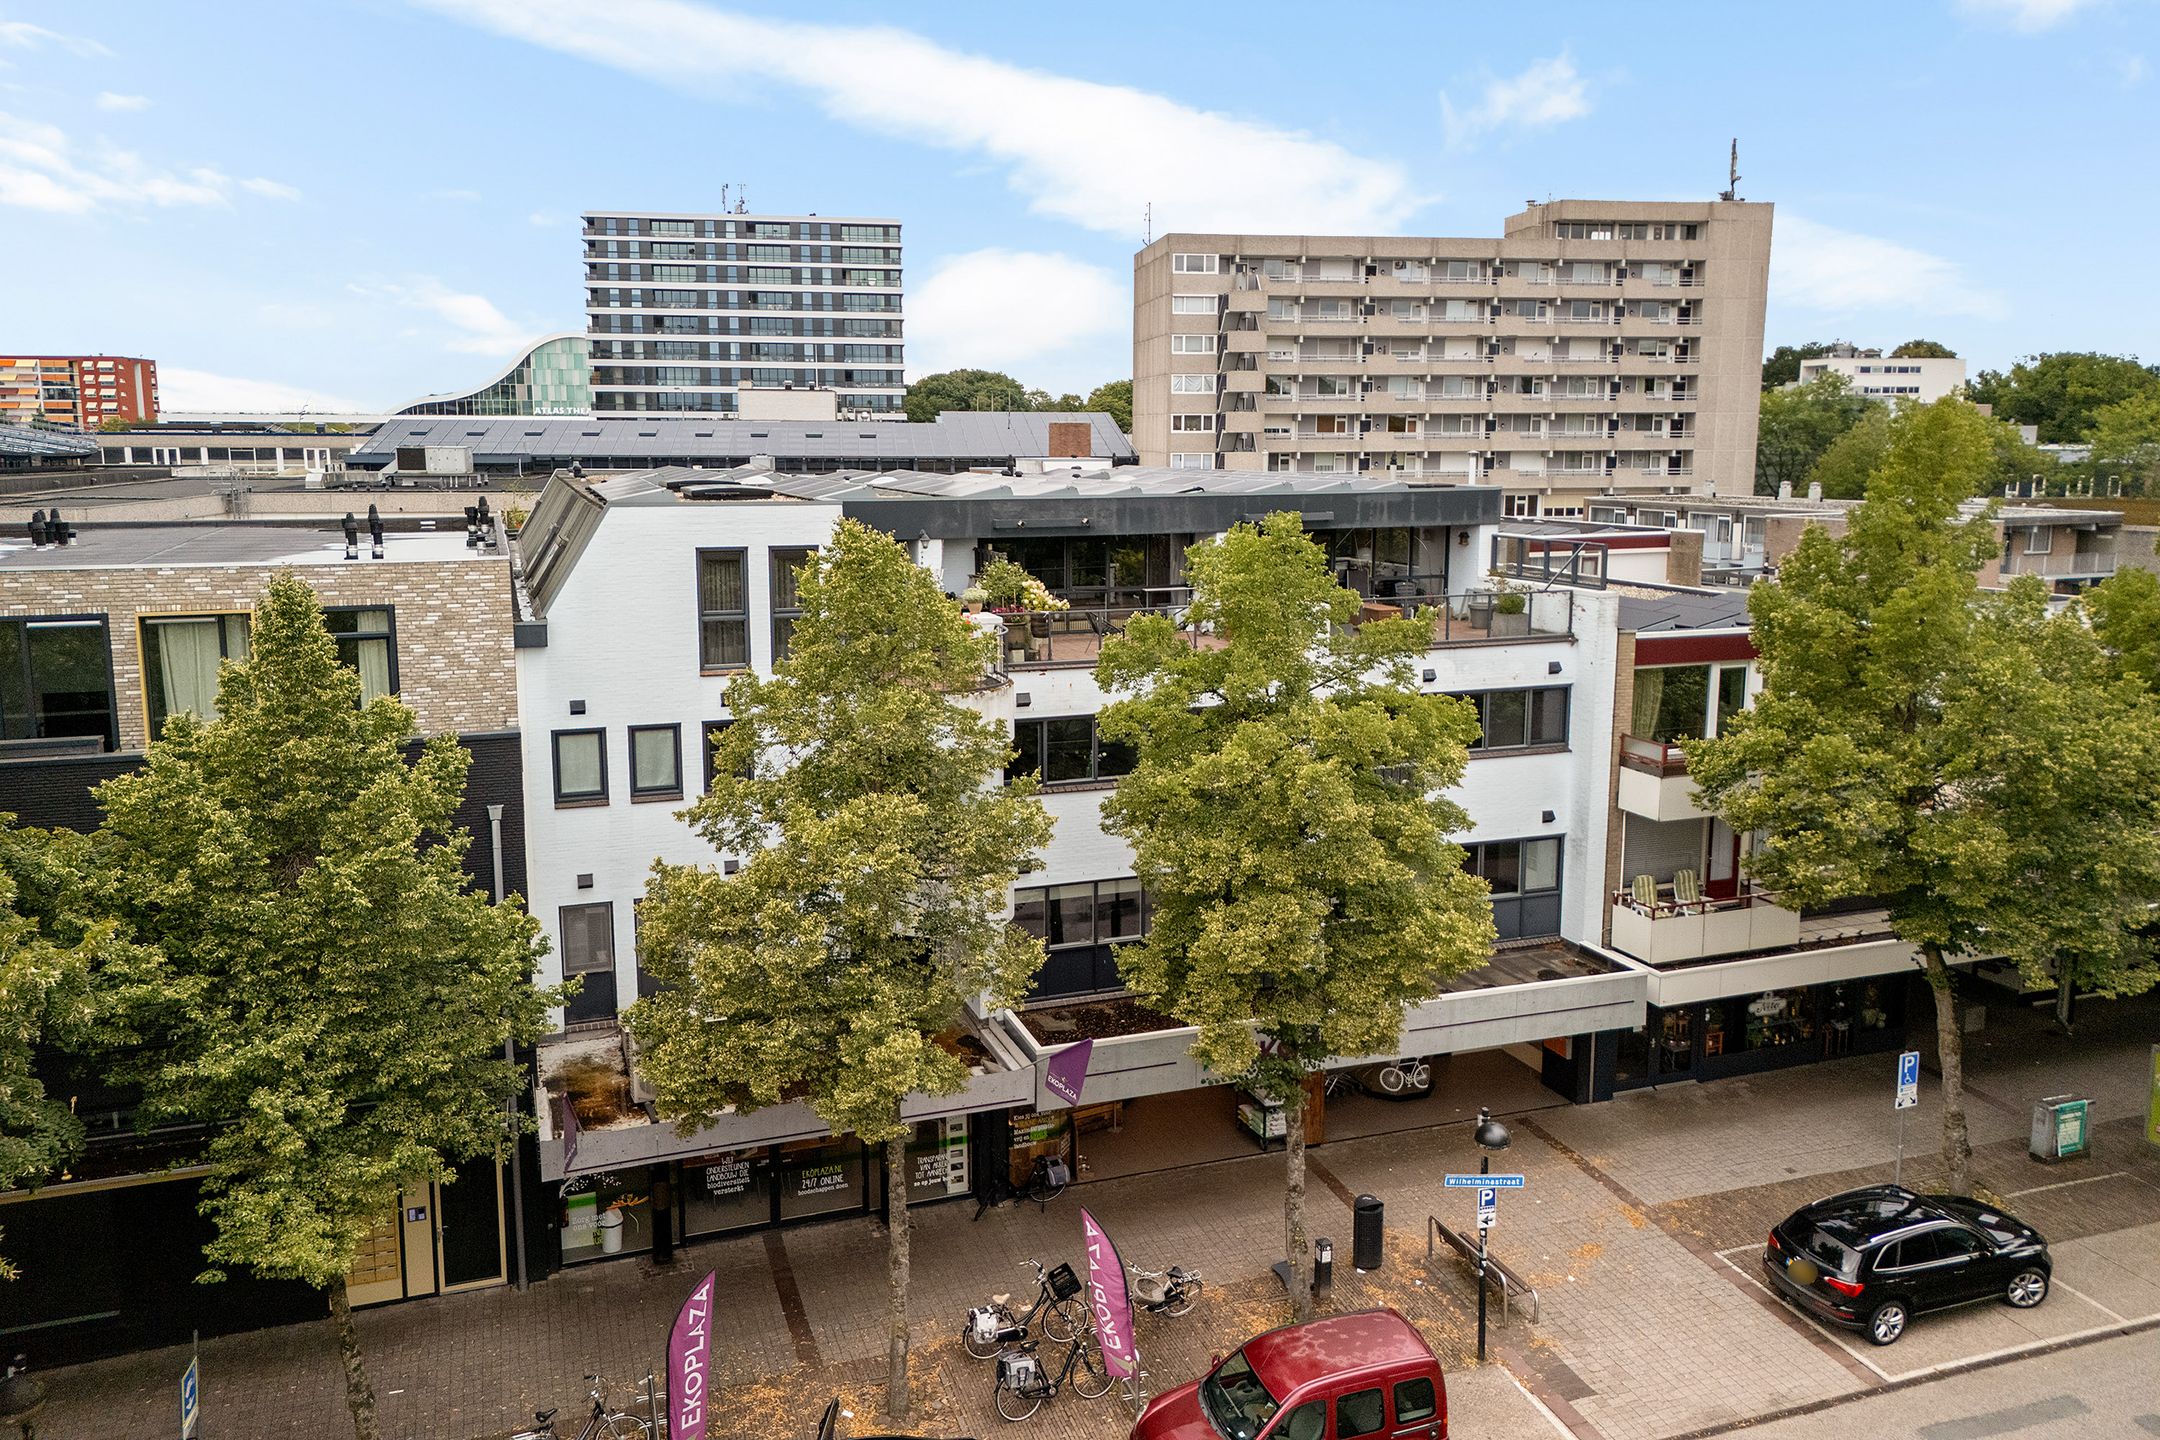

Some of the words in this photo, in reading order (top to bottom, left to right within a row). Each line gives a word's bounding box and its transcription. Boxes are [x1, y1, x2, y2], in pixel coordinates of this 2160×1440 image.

[535, 407, 565, 415] ATLAS
[1904, 1056, 1915, 1073] P
[1047, 1074, 1077, 1100] EKOPLAZA
[706, 1161, 750, 1175] ONDERSTEUNEN
[706, 1170, 738, 1183] LANDBOUW
[706, 1176, 750, 1190] biodiversiteit
[801, 1177, 818, 1189] 24/7
[820, 1173, 844, 1186] ONLINE
[1449, 1178, 1520, 1186] Wilhelminastraat
[713, 1185, 744, 1195] versterkt
[1481, 1190, 1494, 1206] P
[681, 1283, 710, 1430] EKOPLAZA
